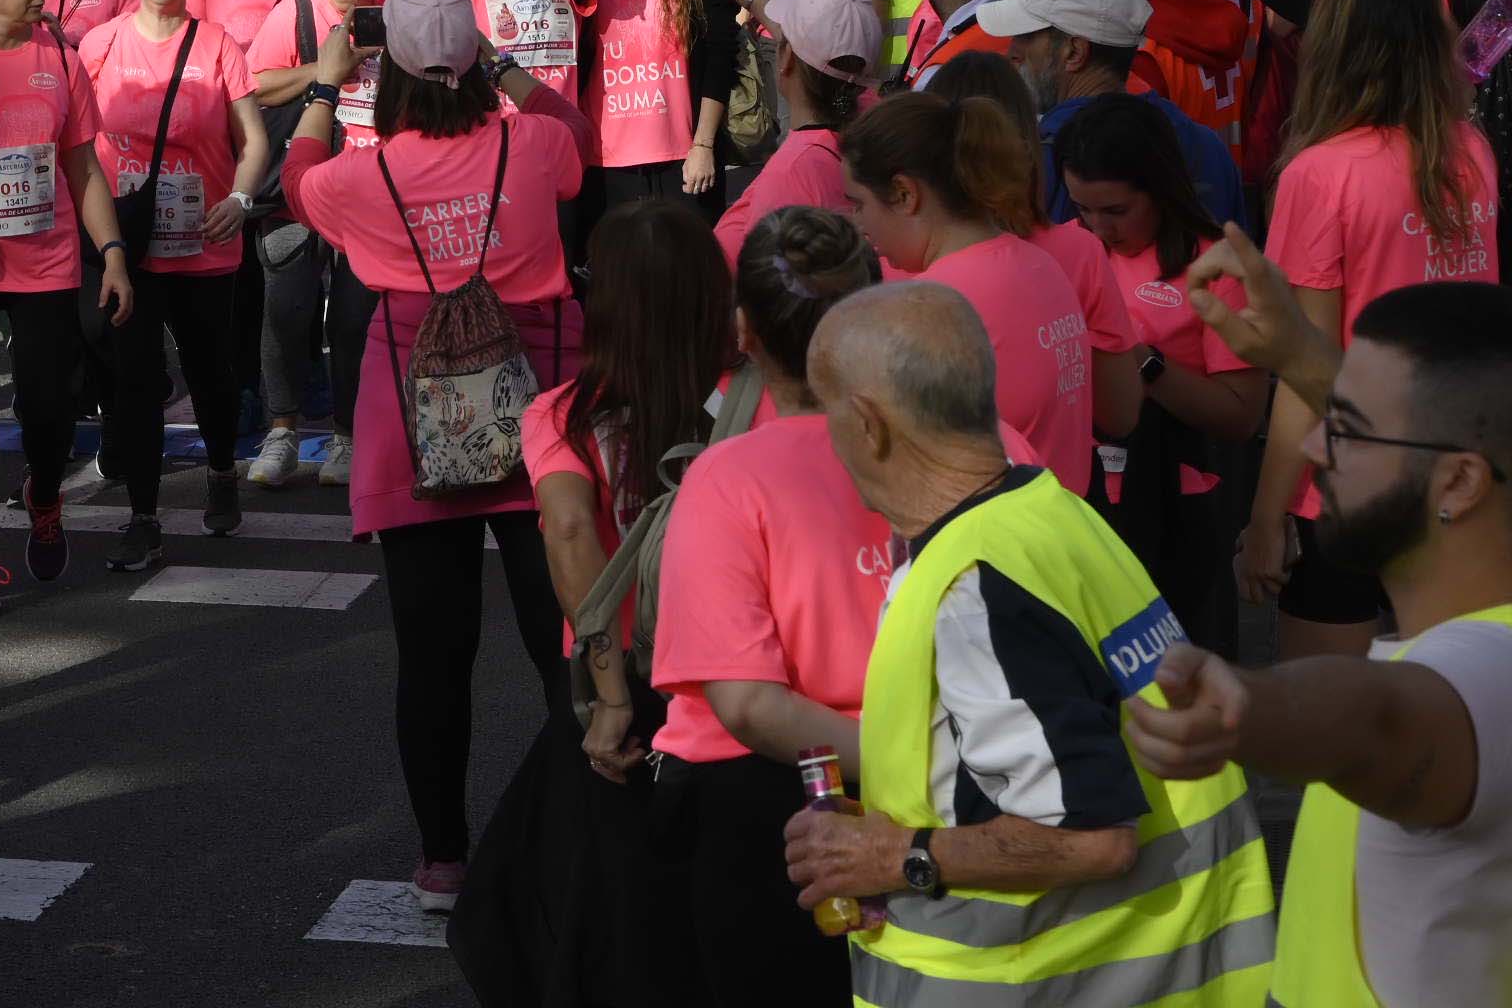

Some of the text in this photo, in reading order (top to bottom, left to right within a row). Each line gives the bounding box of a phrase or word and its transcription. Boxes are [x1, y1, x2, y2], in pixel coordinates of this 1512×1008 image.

[521, 19, 550, 32] 016
[528, 33, 546, 42] 1515
[603, 60, 685, 88] DORSAL
[607, 88, 667, 113] SUMA
[1, 180, 31, 196] 016
[5, 197, 29, 207] 13417
[155, 207, 175, 219] 16
[405, 192, 512, 228] CARRERA
[428, 220, 457, 243] DE
[429, 230, 504, 262] MUJER
[1424, 250, 1488, 282] MUJER
[1139, 287, 1178, 305] ASTURIANA
[1039, 313, 1087, 350] CARRERA
